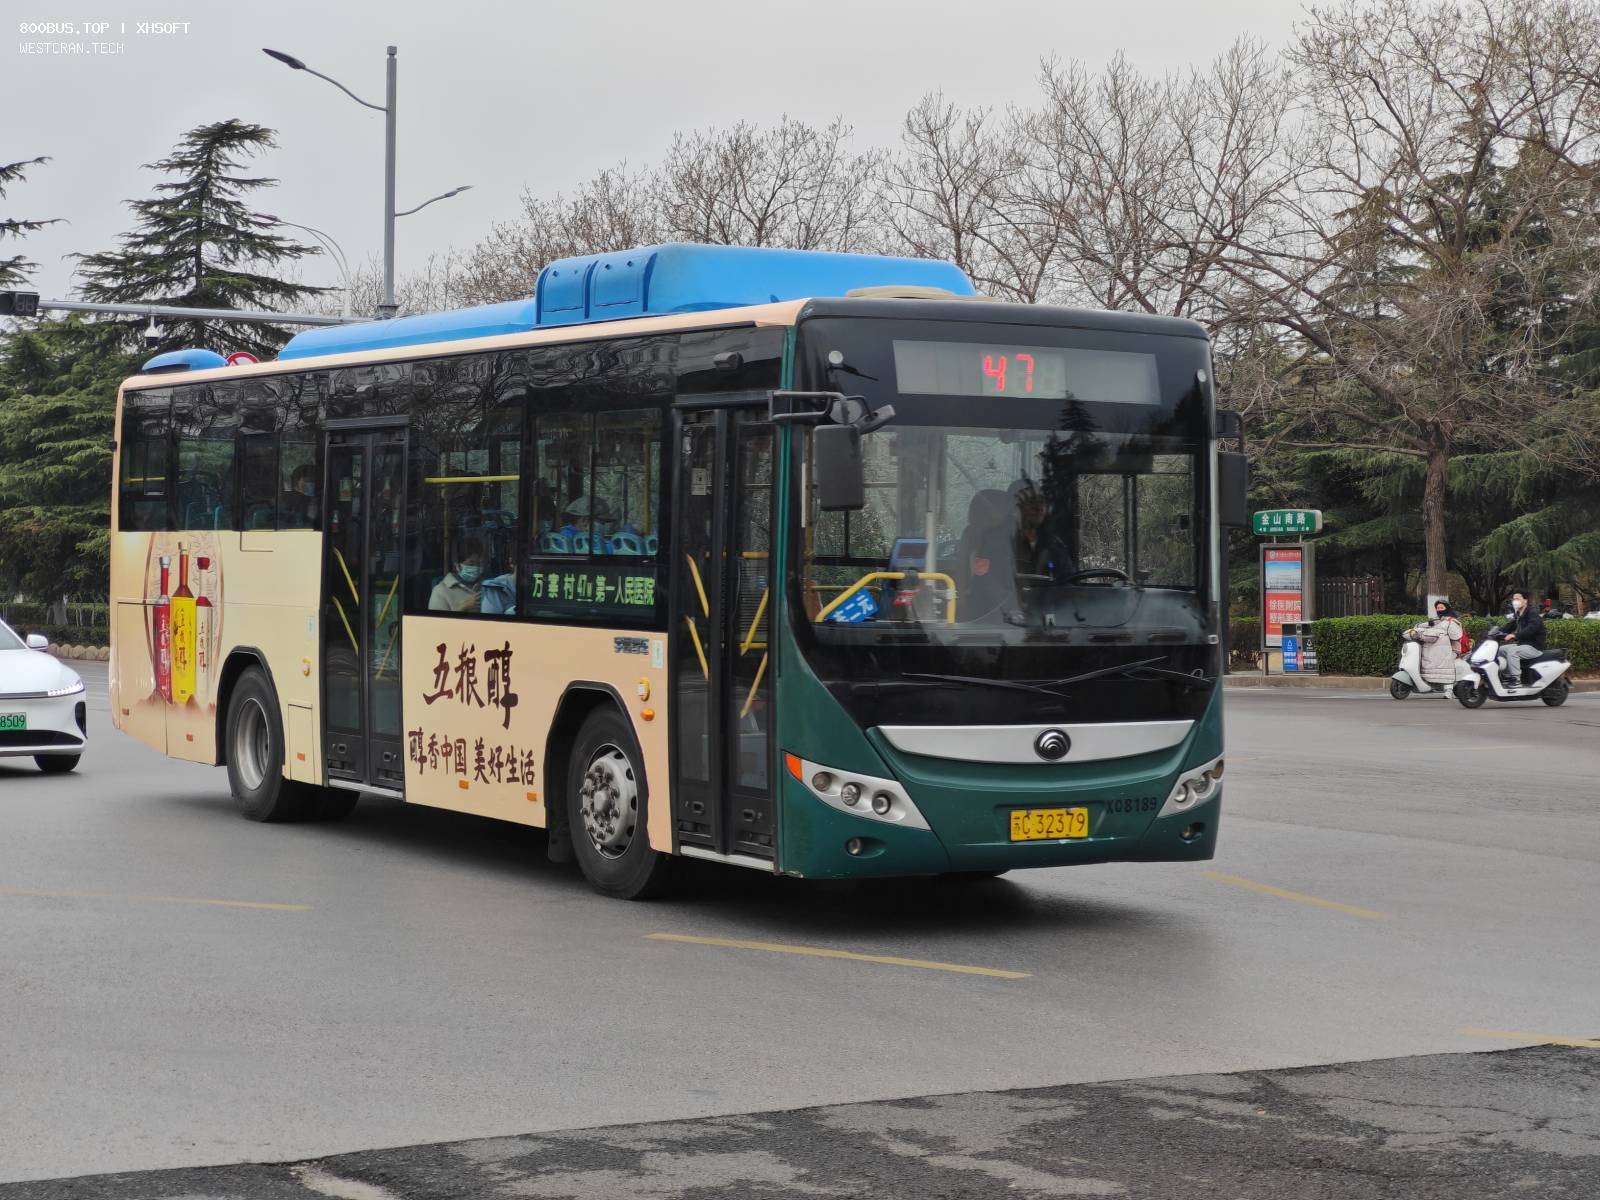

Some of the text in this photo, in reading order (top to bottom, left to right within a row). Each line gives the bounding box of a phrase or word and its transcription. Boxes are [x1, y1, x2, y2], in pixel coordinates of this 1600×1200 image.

[983, 352, 1035, 394] 47
[422, 639, 519, 731] 五粮醇
[408, 726, 536, 787] 醇香中国 美好生活
